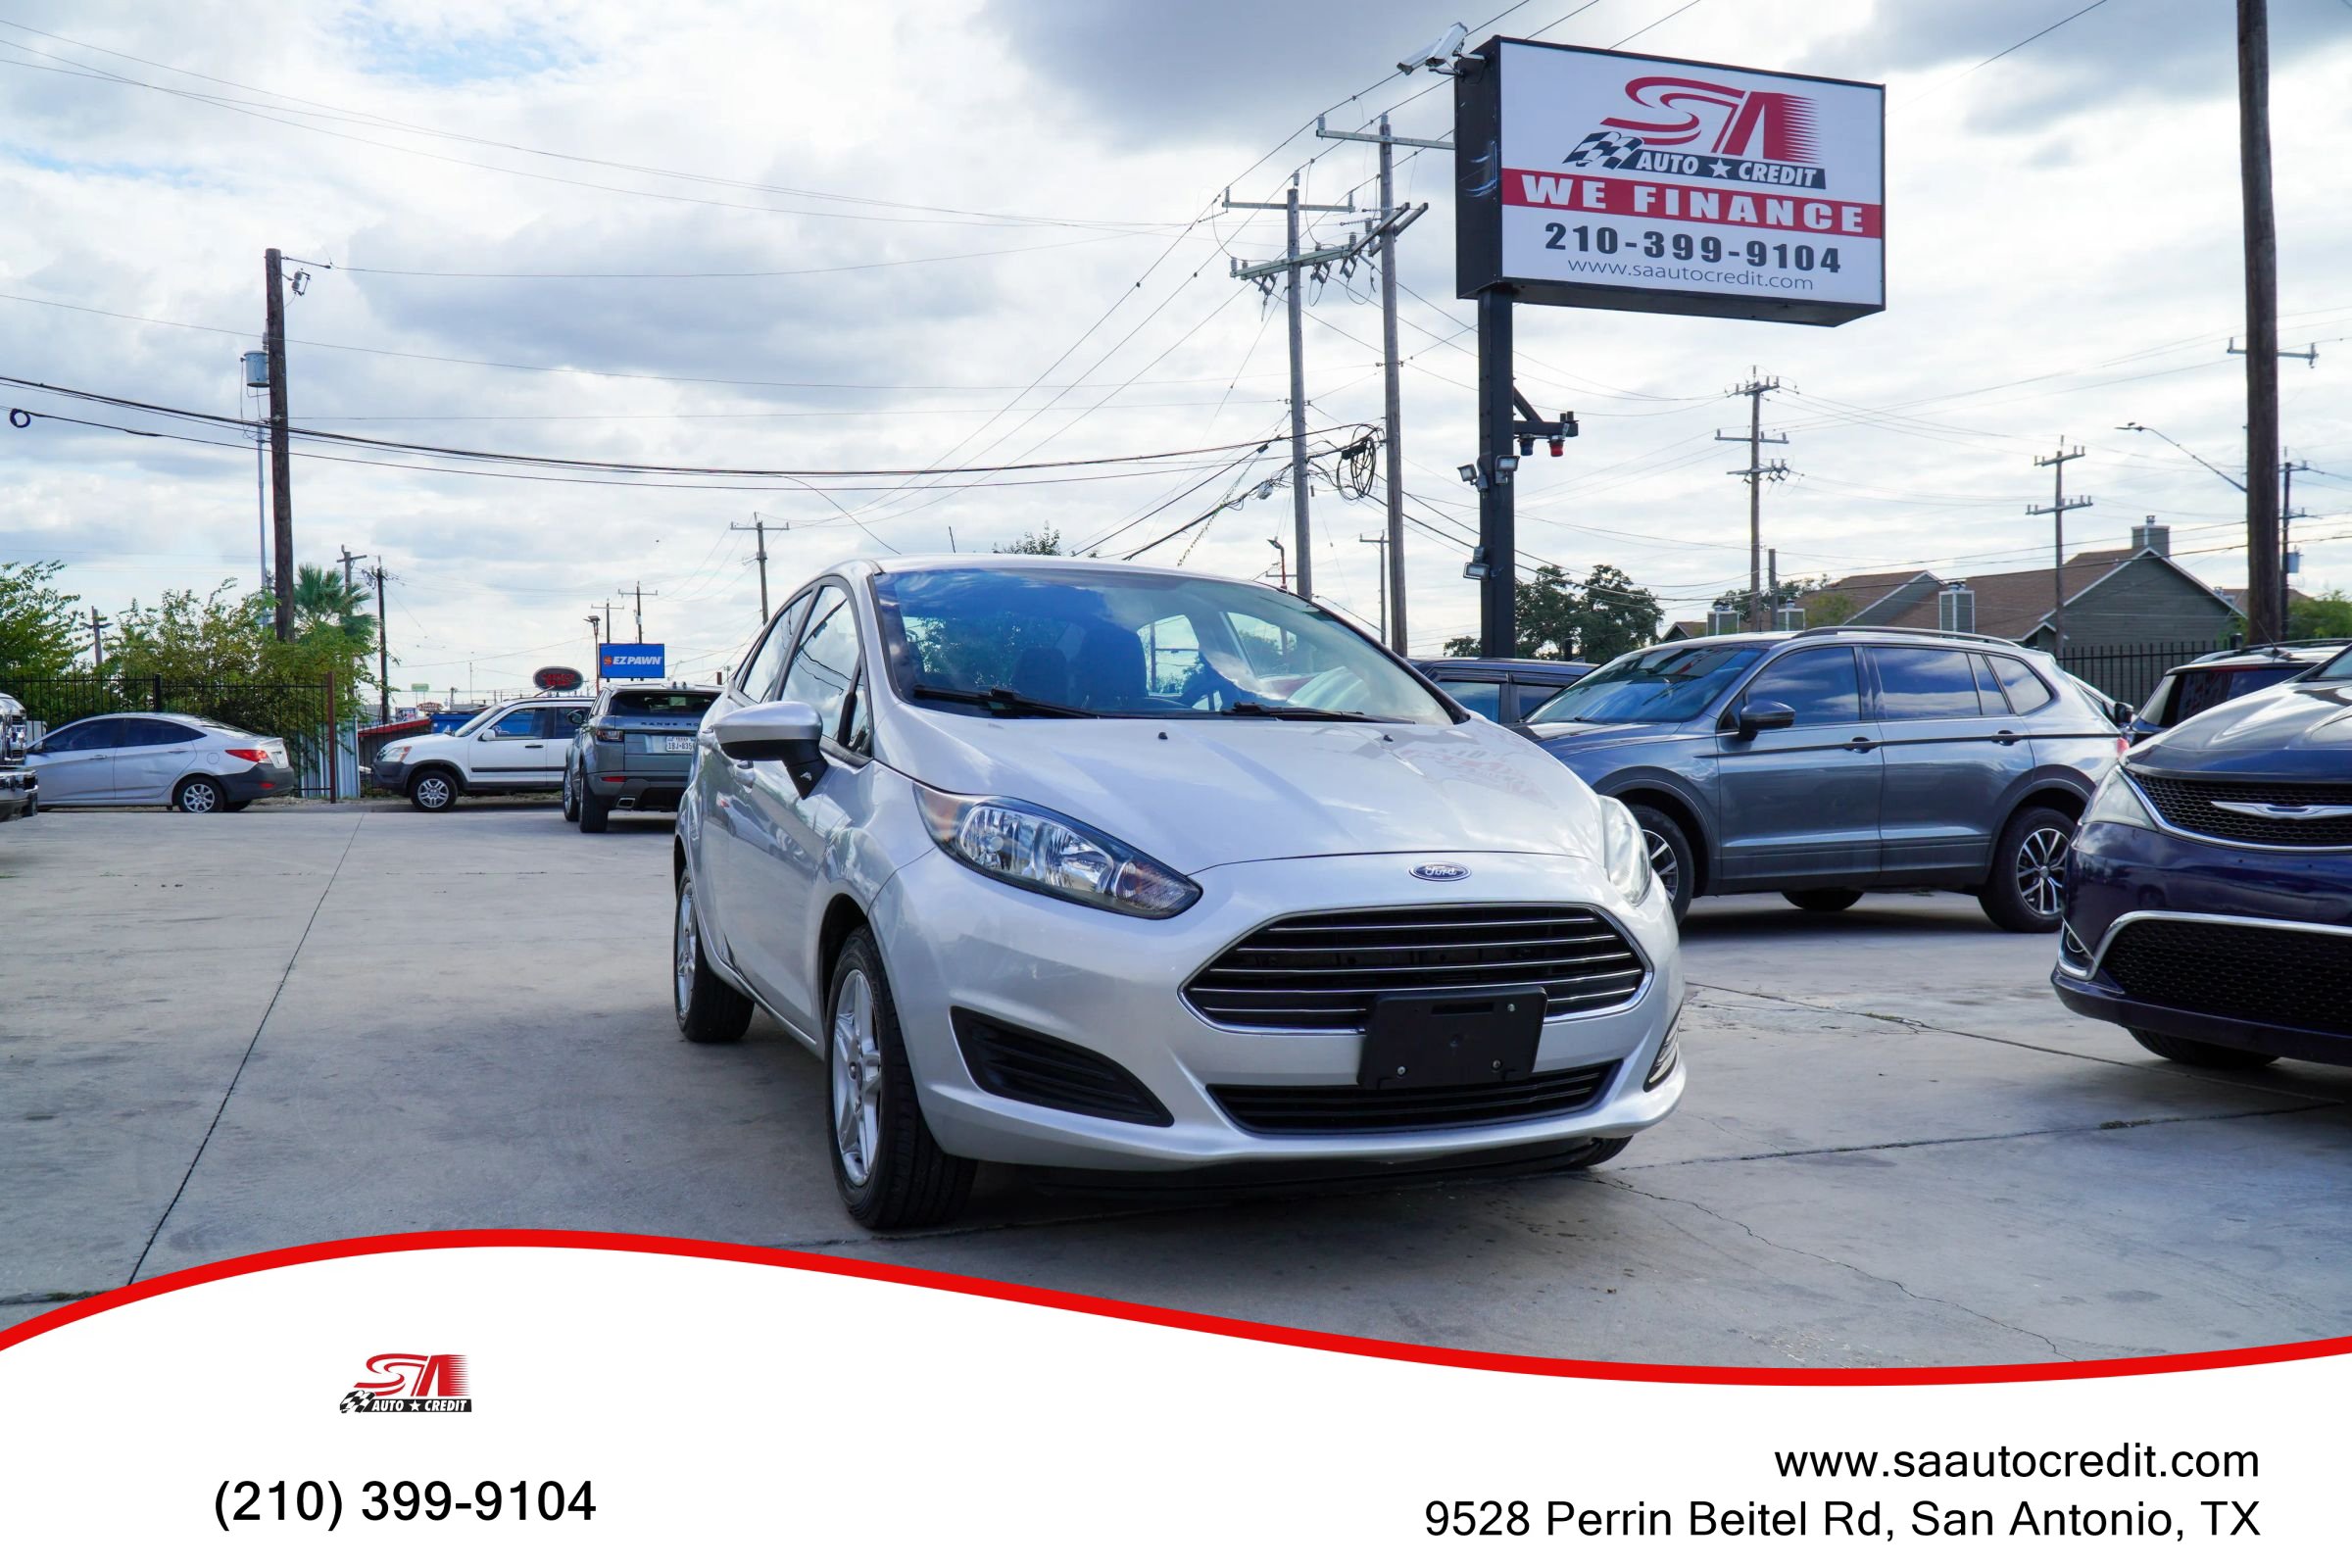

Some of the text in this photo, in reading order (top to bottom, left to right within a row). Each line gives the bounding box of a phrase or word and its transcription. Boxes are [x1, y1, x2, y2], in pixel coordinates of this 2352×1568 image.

[1636, 151, 1817, 187] AUTO CREDIT
[1521, 174, 1864, 234] WE FINANCE
[1544, 221, 1841, 274] 210-399-9104
[1568, 258, 1814, 291] www.saautocredit.com
[1425, 864, 1457, 876] Ford
